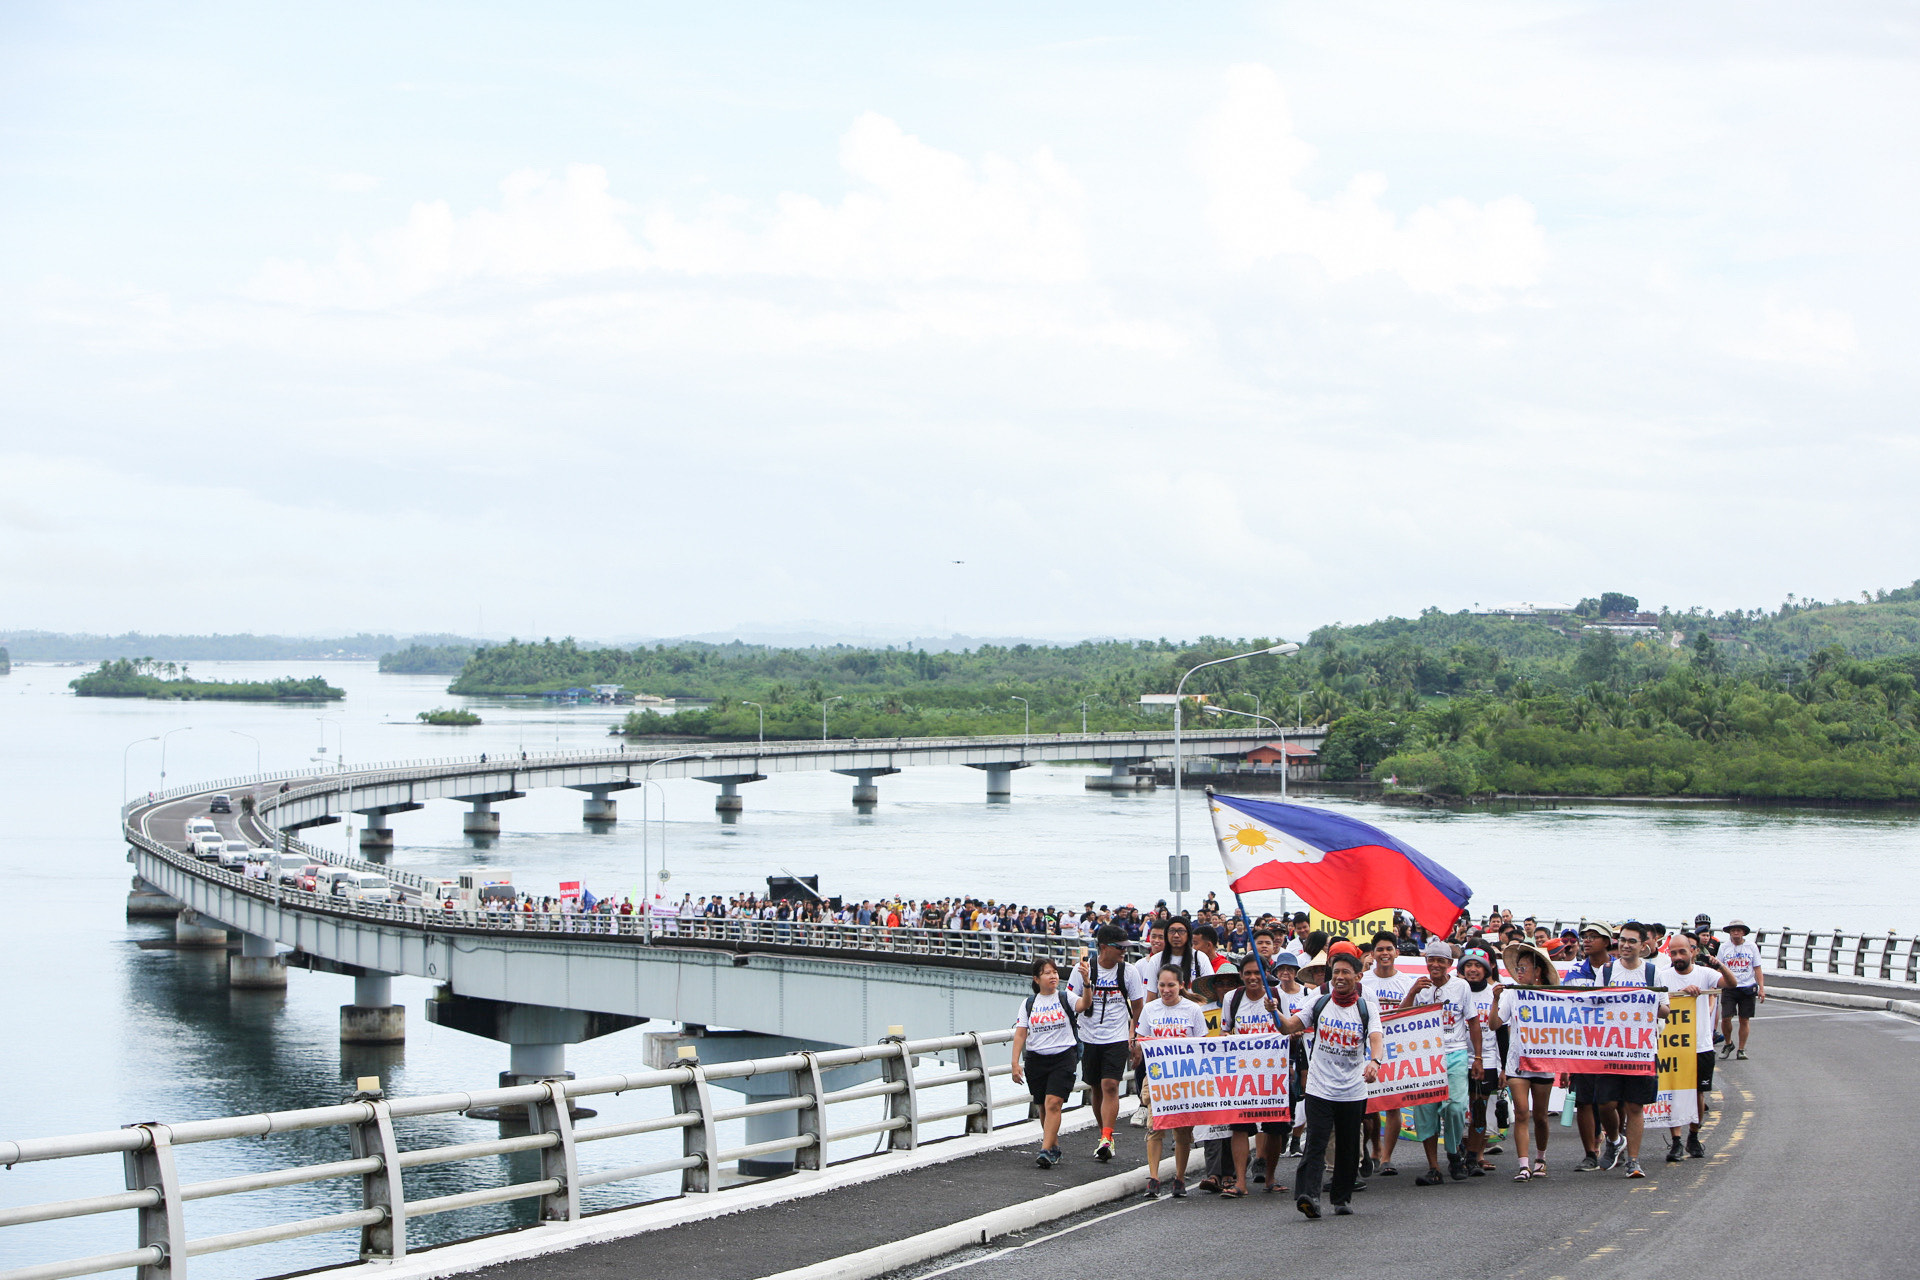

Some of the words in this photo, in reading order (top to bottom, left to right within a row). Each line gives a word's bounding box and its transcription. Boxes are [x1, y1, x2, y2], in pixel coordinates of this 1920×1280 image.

[1316, 919, 1387, 938] JUSTICE
[1376, 989, 1404, 1000] IMATE
[1588, 994, 1656, 1005] TACLOBAN
[1030, 1011, 1065, 1025] WALK
[1152, 1017, 1189, 1025] CLIMATE
[1518, 1005, 1605, 1025] CLIMATE
[1606, 1011, 1654, 1023] 2023
[1320, 1016, 1363, 1032] CLIMATE
[1323, 1025, 1356, 1037] JUSTICE
[1153, 1029, 1188, 1038] WALK
[1319, 1029, 1360, 1046] WALK
[1520, 1026, 1582, 1045] JUSTICE
[1582, 1026, 1653, 1049] WALK
[1145, 1045, 1194, 1058] MANILA
[1199, 1042, 1217, 1054] TO
[1222, 1039, 1289, 1052] TACLOBAN
[1396, 1036, 1443, 1053] 2023
[1528, 1048, 1557, 1056] PEOPLE'S
[1558, 1049, 1585, 1057] JOURNEY
[1626, 1051, 1650, 1059] JUSTICE
[1148, 1056, 1237, 1080] CLIMATE
[1238, 1057, 1288, 1068] 2023
[1376, 1054, 1446, 1083] WALK
[1151, 1080, 1214, 1102] JUSTICE
[1215, 1074, 1287, 1097] WALK
[1396, 1083, 1420, 1091] CLIMATE
[1421, 1079, 1445, 1088] JUSTICE
[1162, 1103, 1190, 1112] PEOPLE'S
[1191, 1101, 1218, 1109] JOURNEY
